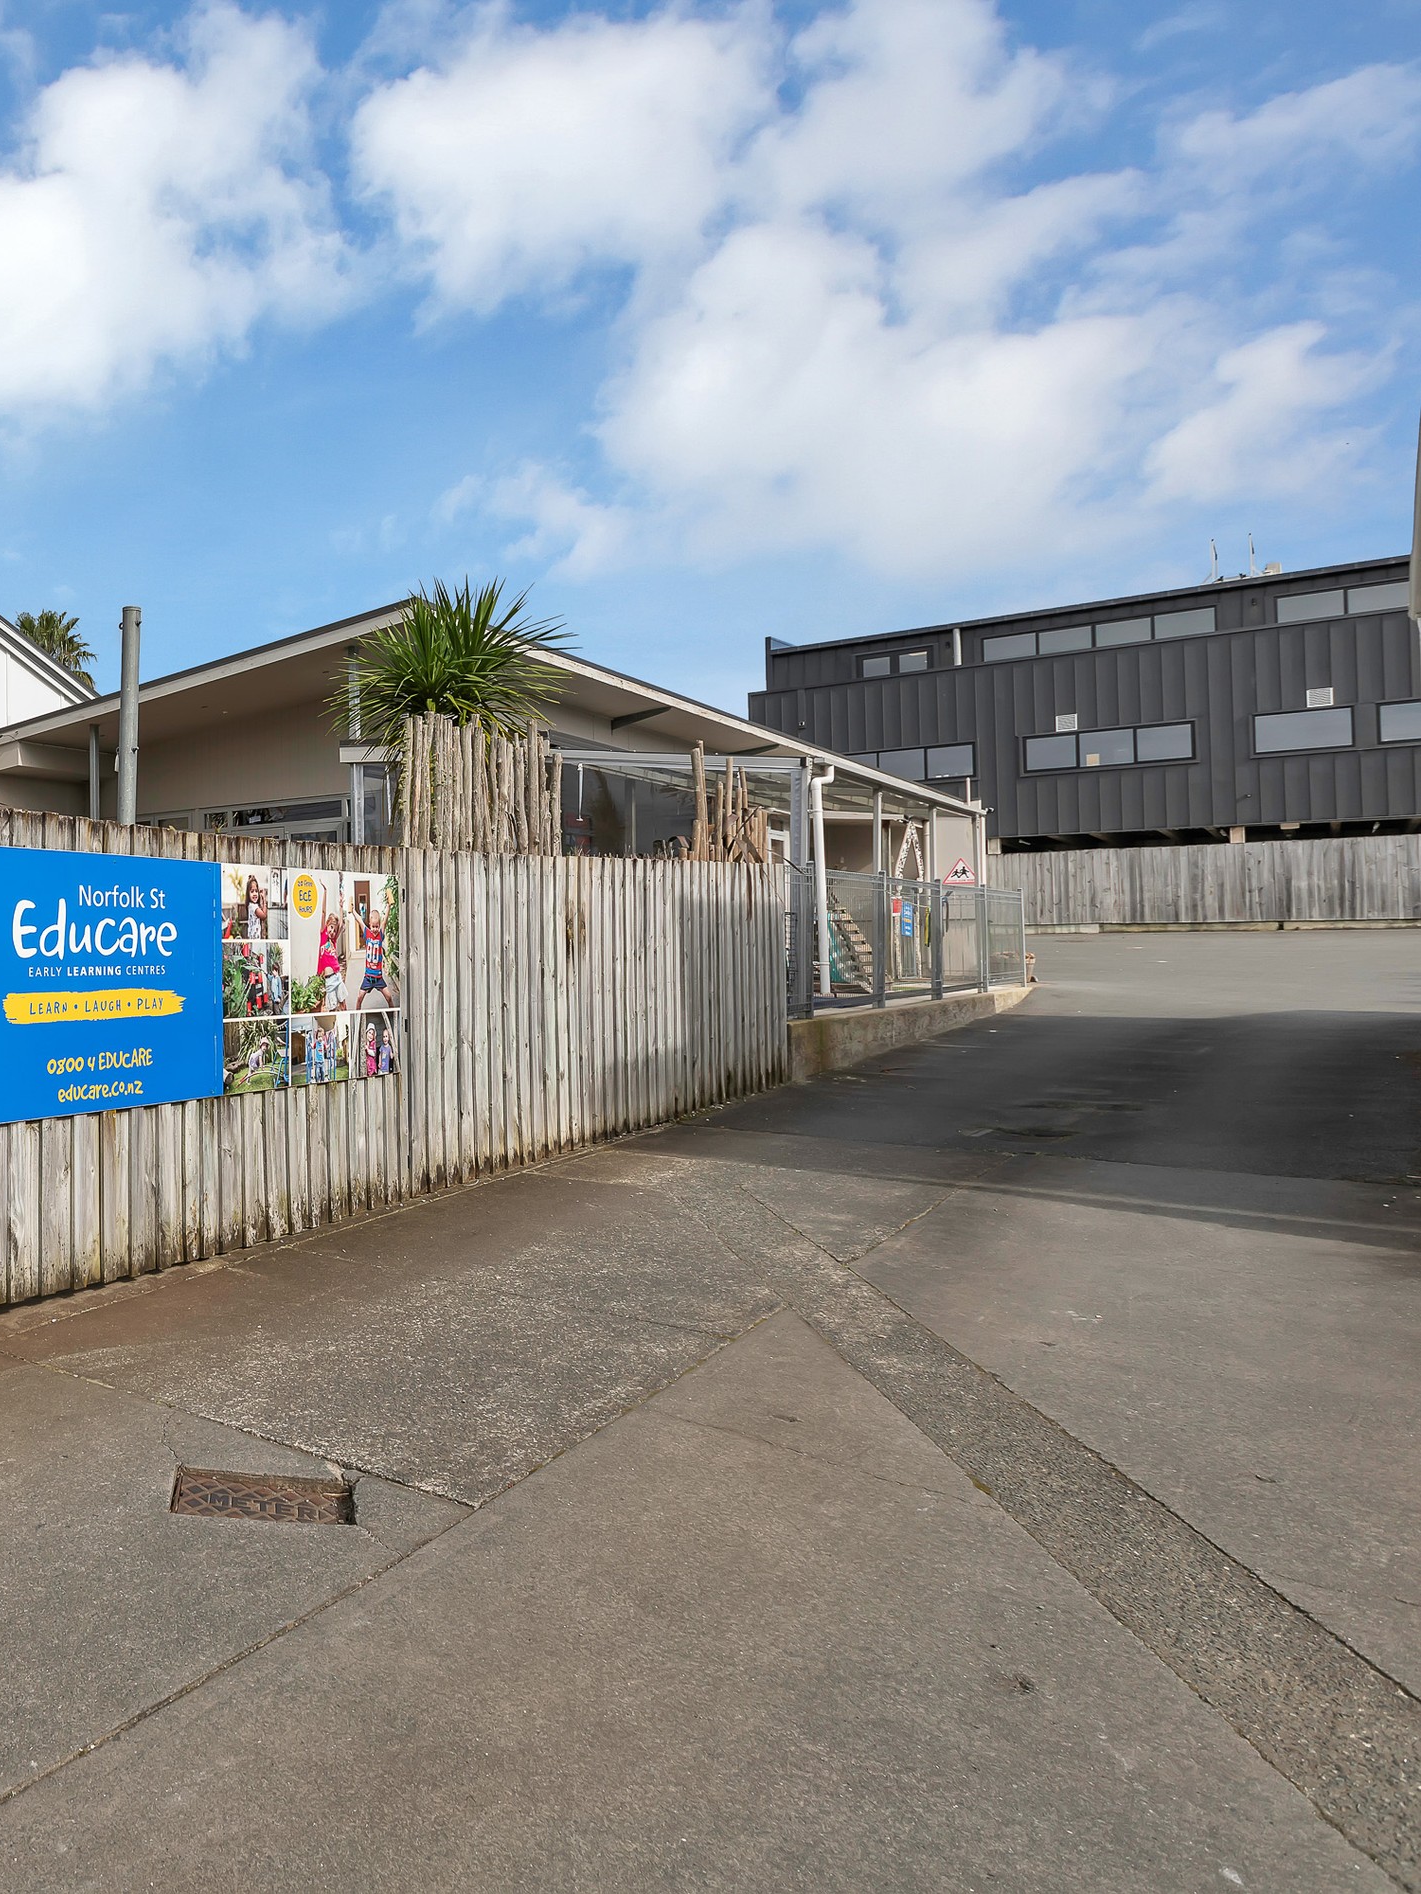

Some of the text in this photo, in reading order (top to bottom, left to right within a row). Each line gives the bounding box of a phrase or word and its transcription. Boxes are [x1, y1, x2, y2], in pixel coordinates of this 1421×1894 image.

[78, 884, 166, 910] Norfolk St
[298, 889, 312, 901] ECE
[12, 898, 178, 960] Educare
[28, 964, 166, 977] EARLY LEARNING CENTRES
[29, 998, 164, 1016] LEARN LAUGH PLAY
[46, 1056, 85, 1075] 0800
[87, 1056, 96, 1072] 4
[57, 1080, 144, 1103] educare.co.nz
[207, 1492, 319, 1521] METER
